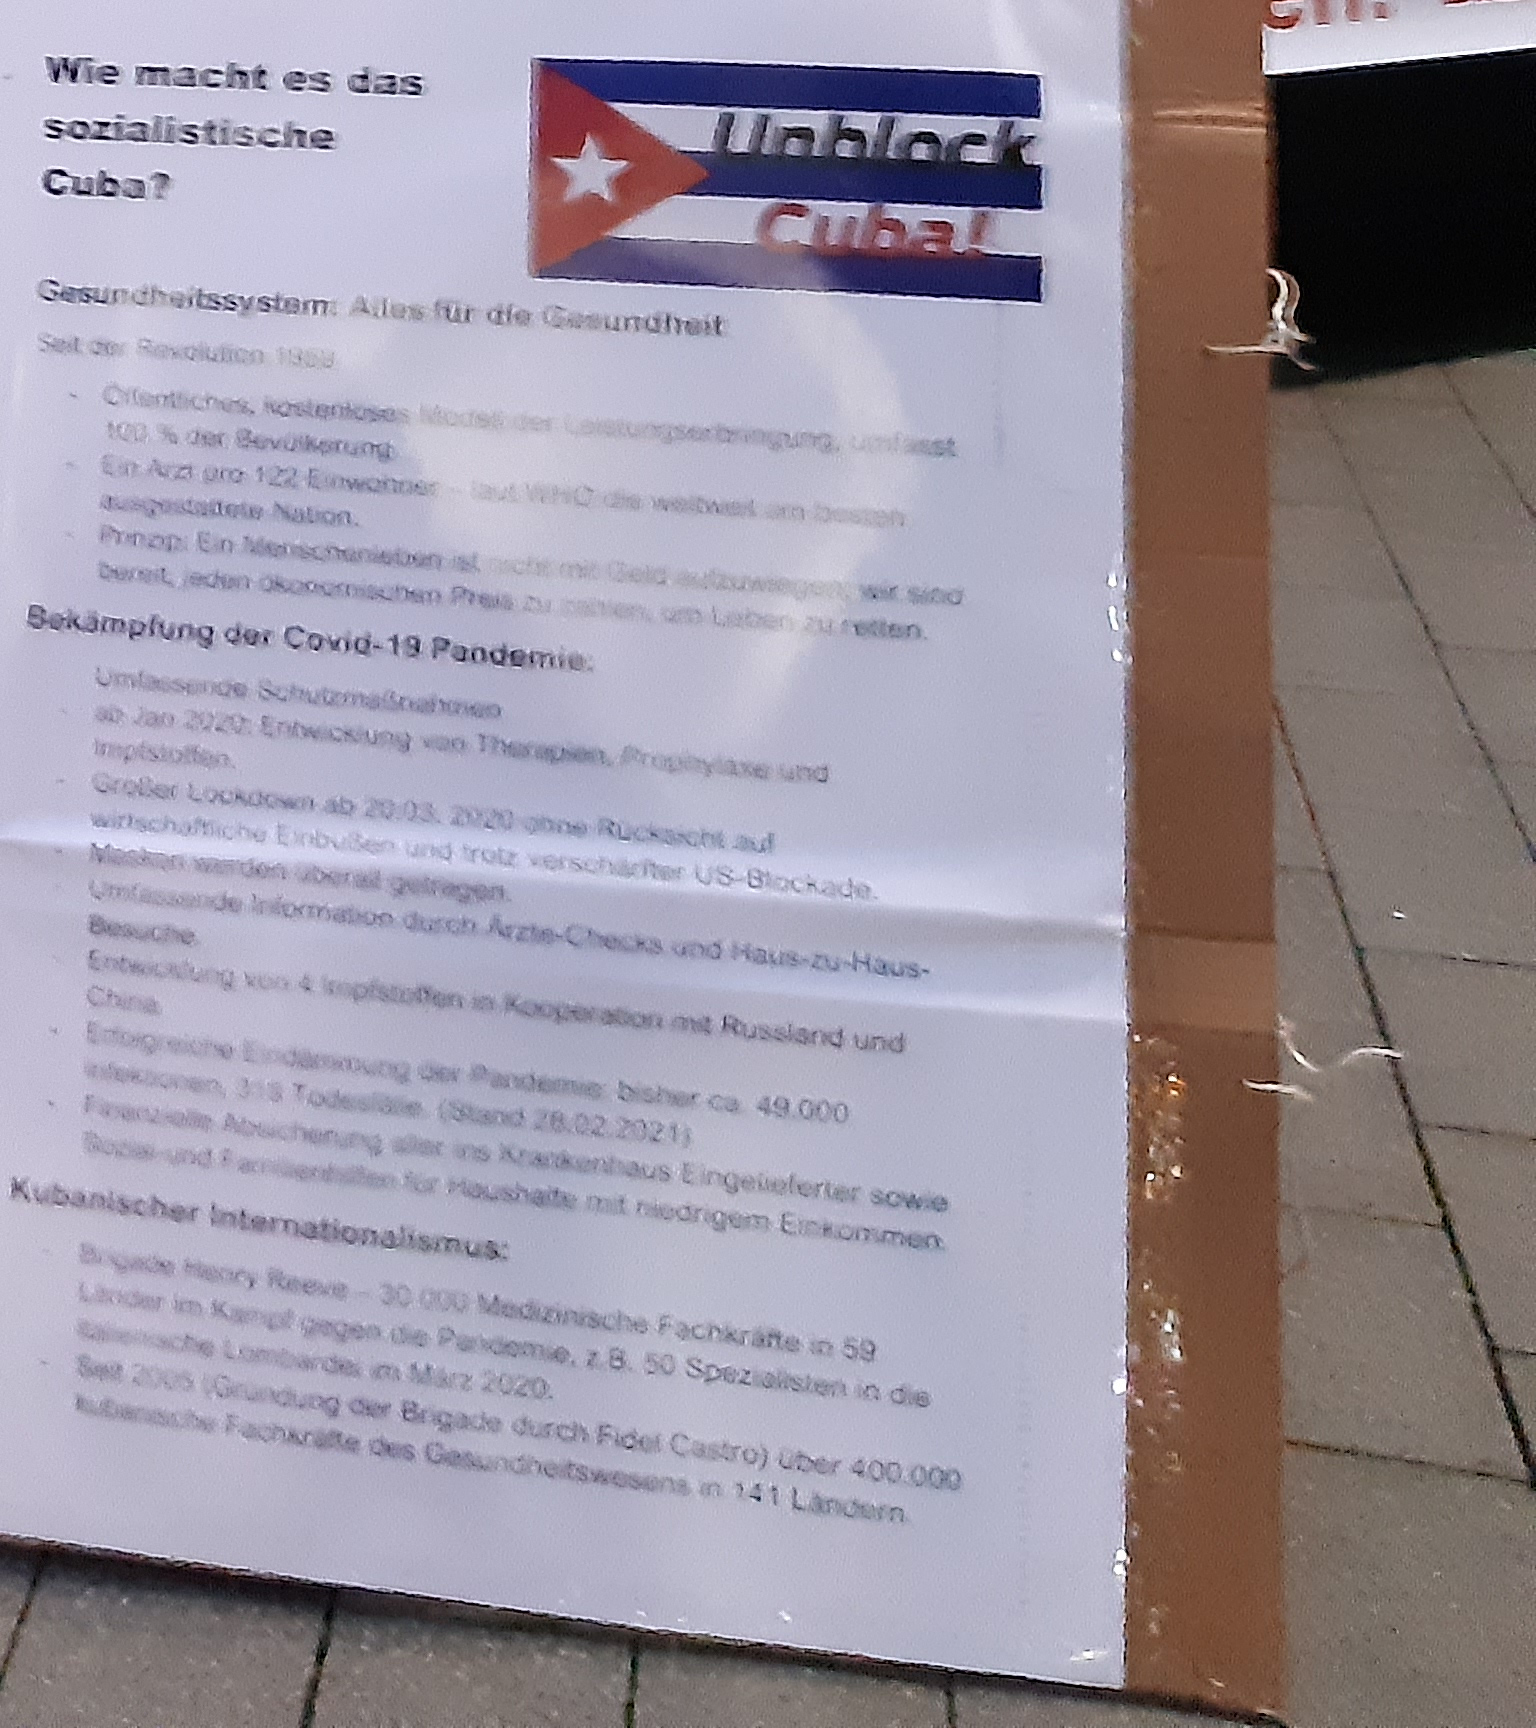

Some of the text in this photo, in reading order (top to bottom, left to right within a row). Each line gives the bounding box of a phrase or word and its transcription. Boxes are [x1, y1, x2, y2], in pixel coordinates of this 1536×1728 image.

[44, 55, 425, 97] Wie macht es das
[43, 113, 337, 151] sozialistische
[712, 111, 1036, 167] Unblock
[41, 168, 172, 199] Cuba?
[755, 202, 994, 260] Cuba!
[350, 294, 425, 321] Alles
[436, 299, 473, 325] für
[487, 305, 532, 328] die
[542, 305, 723, 337] Gesundheit
[27, 604, 594, 673] Bekämpfung der Covid-19 Pandemie:
[693, 863, 878, 902] US-Blockade.
[731, 940, 930, 979] Haus-zu-Haus-
[721, 1012, 845, 1051] Russland
[854, 1032, 906, 1054] und
[757, 1095, 850, 1124] 49.000
[10, 1175, 509, 1261] Kubanischer Internationalismus:
